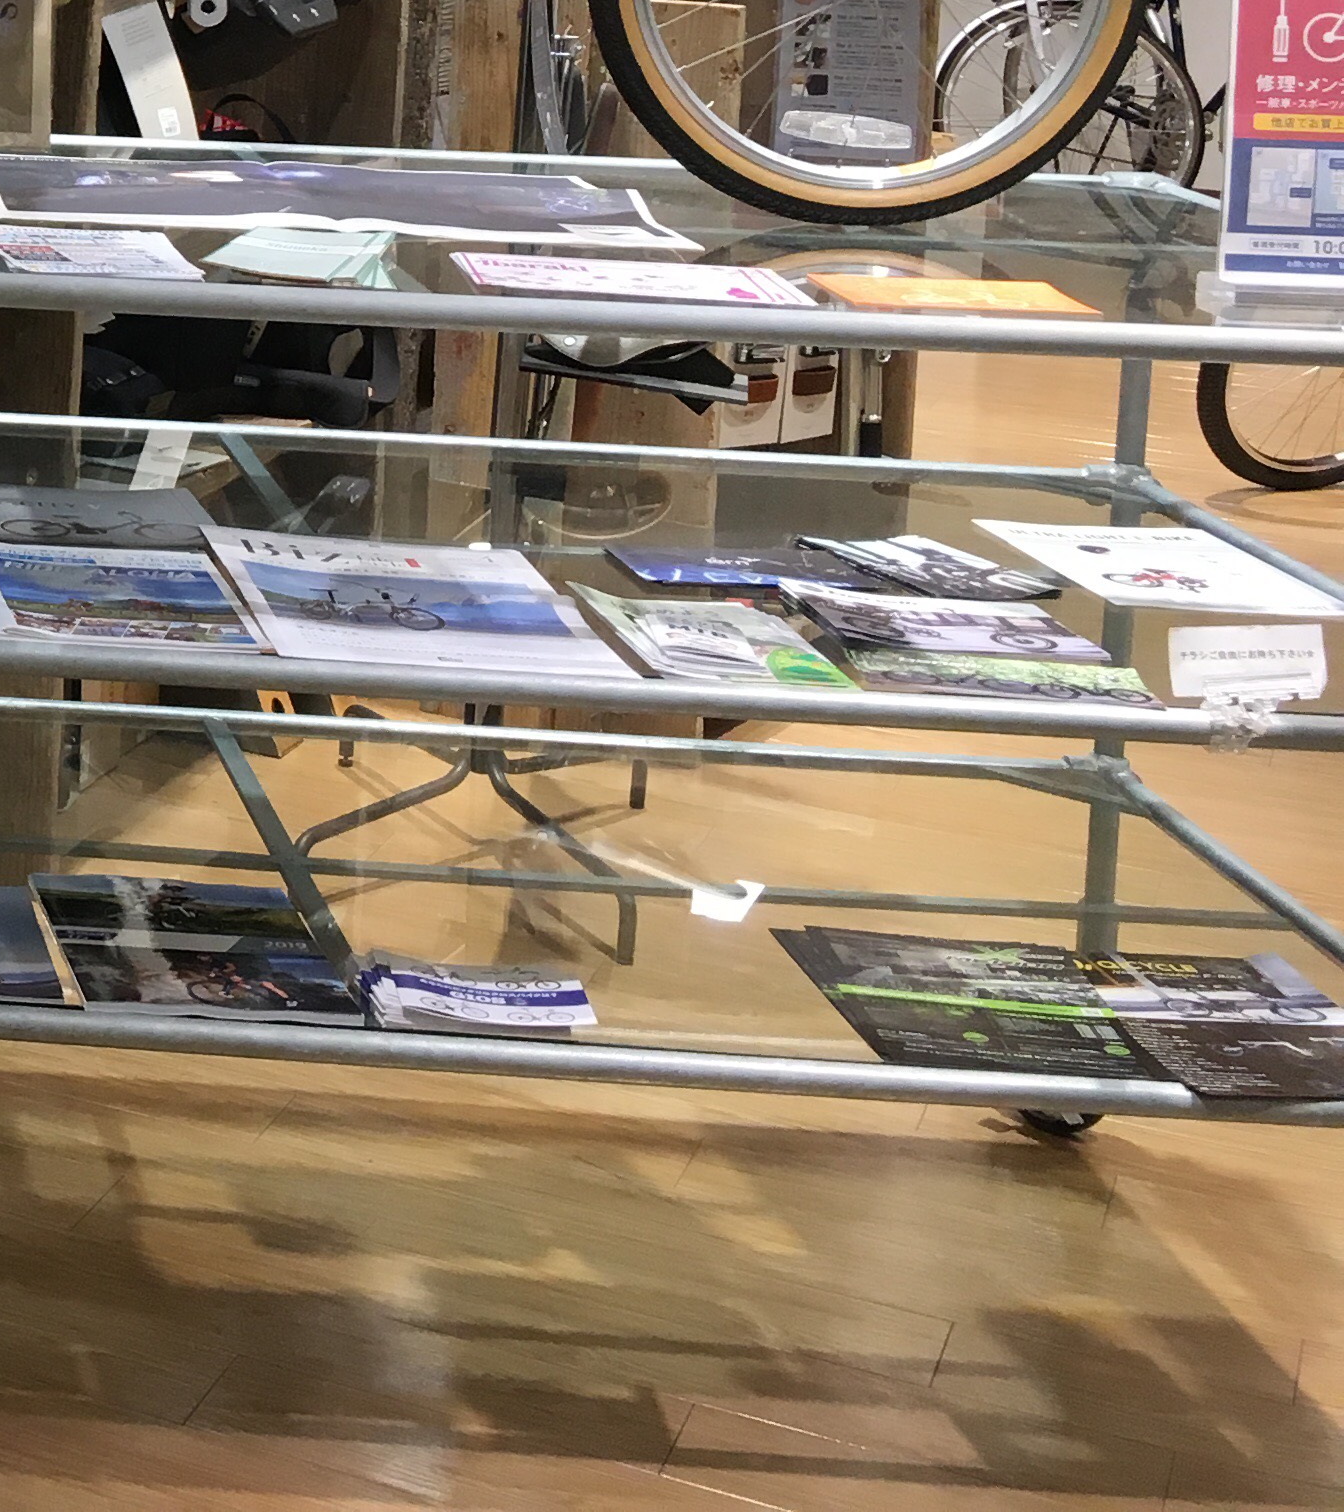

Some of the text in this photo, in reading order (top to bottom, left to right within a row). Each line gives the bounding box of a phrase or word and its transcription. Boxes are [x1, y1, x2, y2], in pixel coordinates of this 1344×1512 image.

[1255, 74, 1344, 95] 修理・メン
